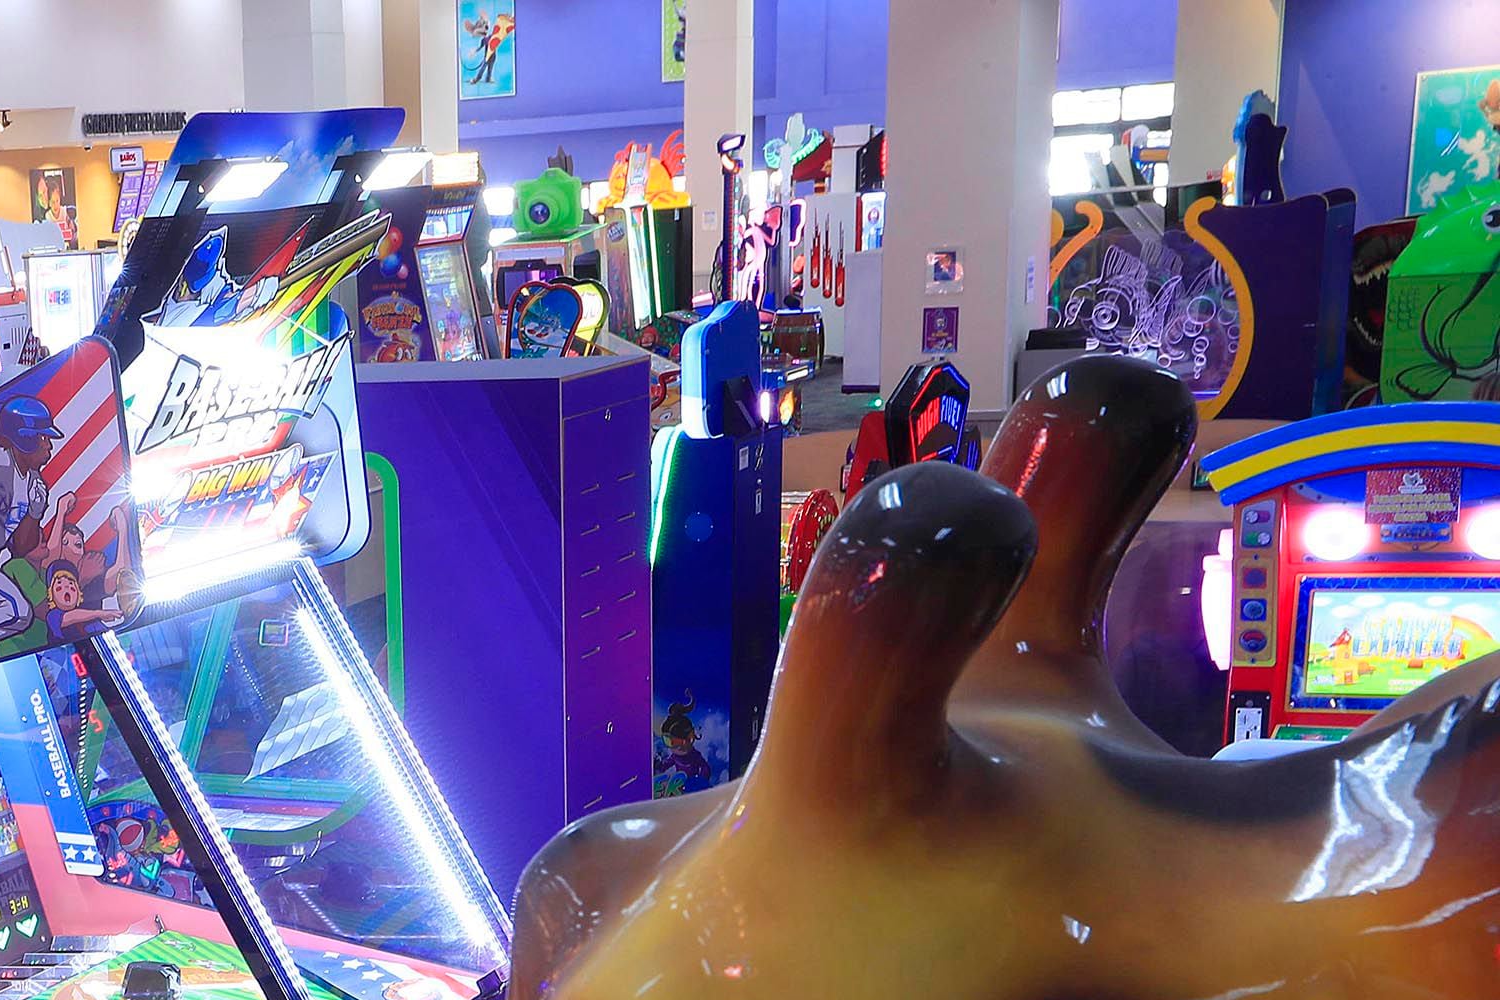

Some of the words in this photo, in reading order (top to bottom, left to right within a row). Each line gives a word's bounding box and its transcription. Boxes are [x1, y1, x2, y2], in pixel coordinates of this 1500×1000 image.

[916, 397, 941, 446] HIGH
[940, 395, 962, 432] FIVE!
[186, 464, 235, 505] BIG
[226, 454, 281, 495] WIN
[41, 720, 71, 799] BASEBALL
